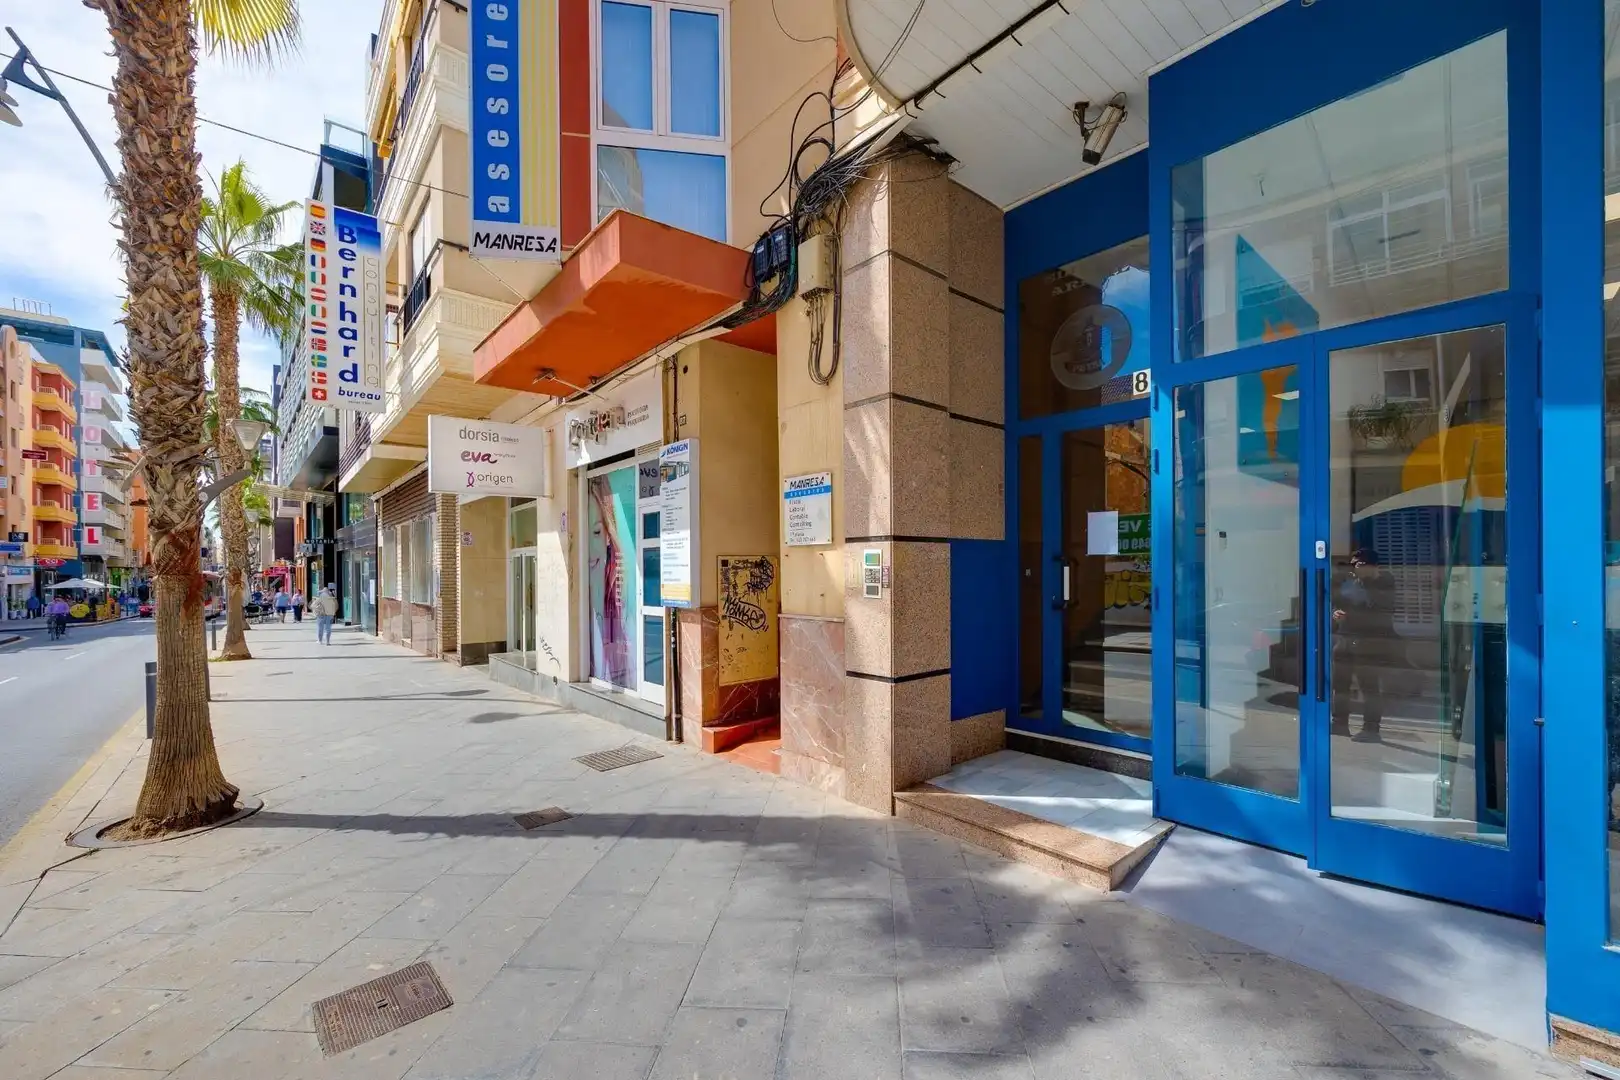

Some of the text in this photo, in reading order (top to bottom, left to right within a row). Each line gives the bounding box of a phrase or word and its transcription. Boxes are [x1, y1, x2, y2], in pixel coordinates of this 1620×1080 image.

[473, 231, 558, 254] MANRESA
[338, 225, 358, 384] Bernhard
[1134, 371, 1149, 393] 8
[338, 386, 381, 401] bureau
[459, 425, 500, 442] dorsia
[460, 450, 498, 464] eva
[85, 391, 99, 543] HOTEL
[476, 472, 514, 485] origen
[790, 476, 825, 489] MANRESA
